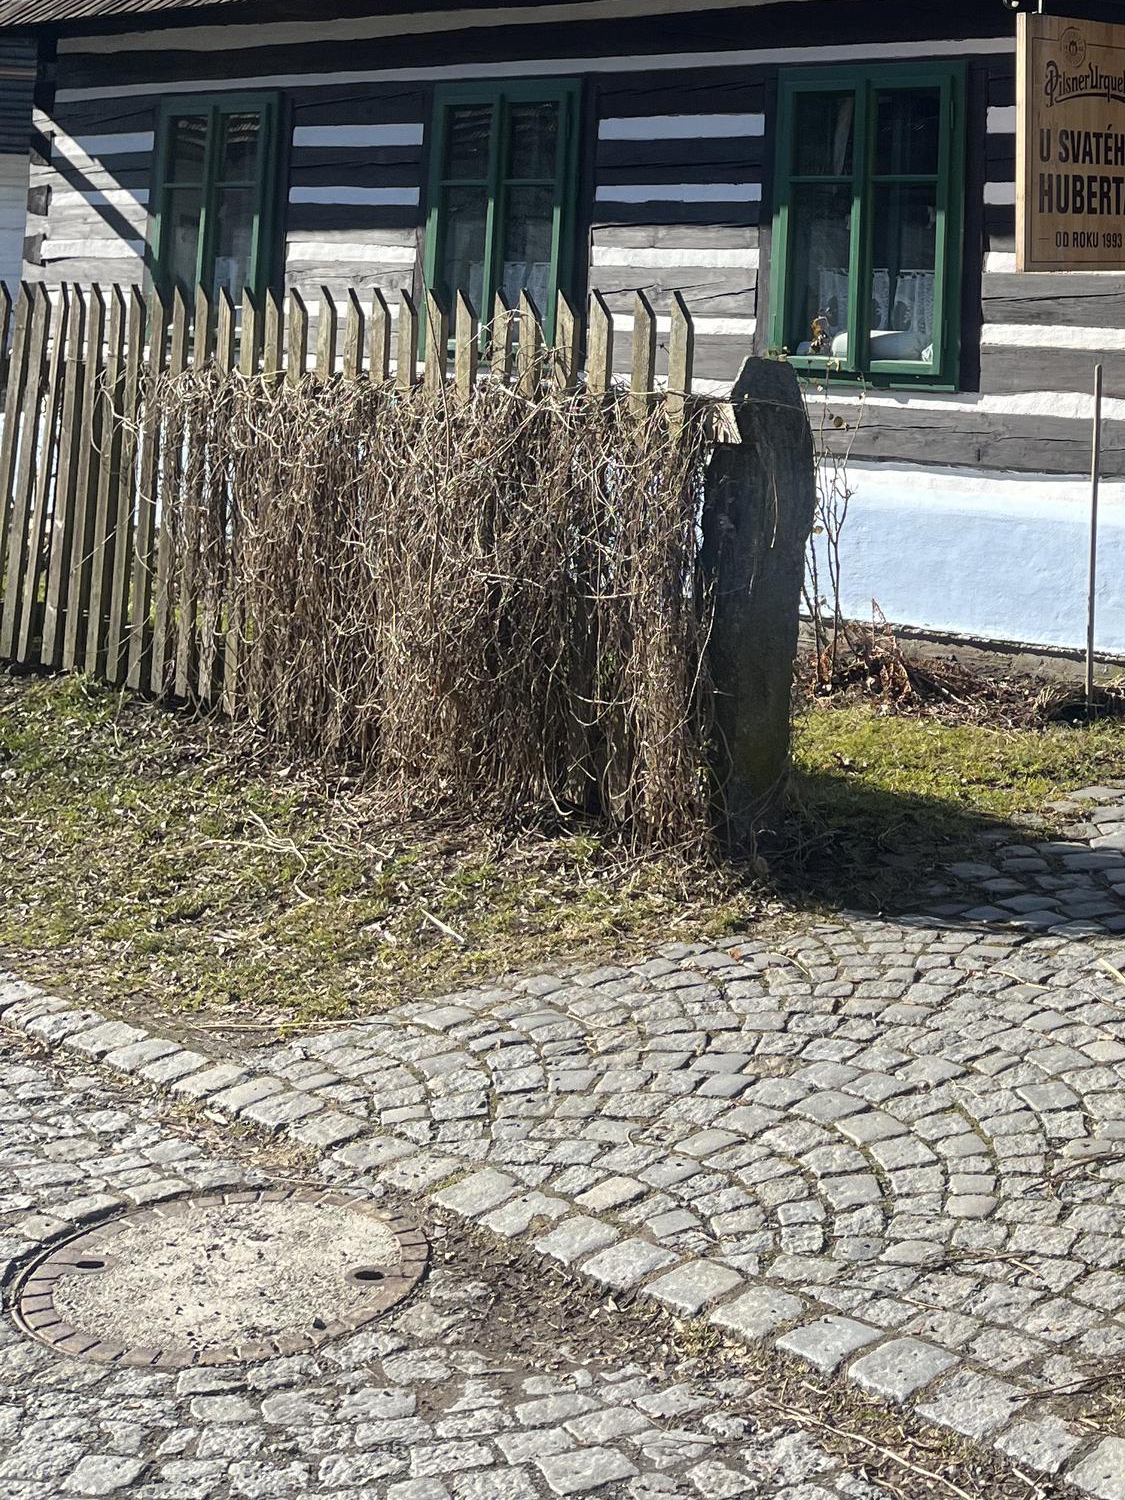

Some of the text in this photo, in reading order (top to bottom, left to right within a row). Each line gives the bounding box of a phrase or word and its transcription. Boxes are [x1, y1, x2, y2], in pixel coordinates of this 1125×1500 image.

[1044, 60, 1090, 107] Pilsner
[1039, 128, 1051, 162] U
[1055, 231, 1123, 249] OD ROKU 1993
